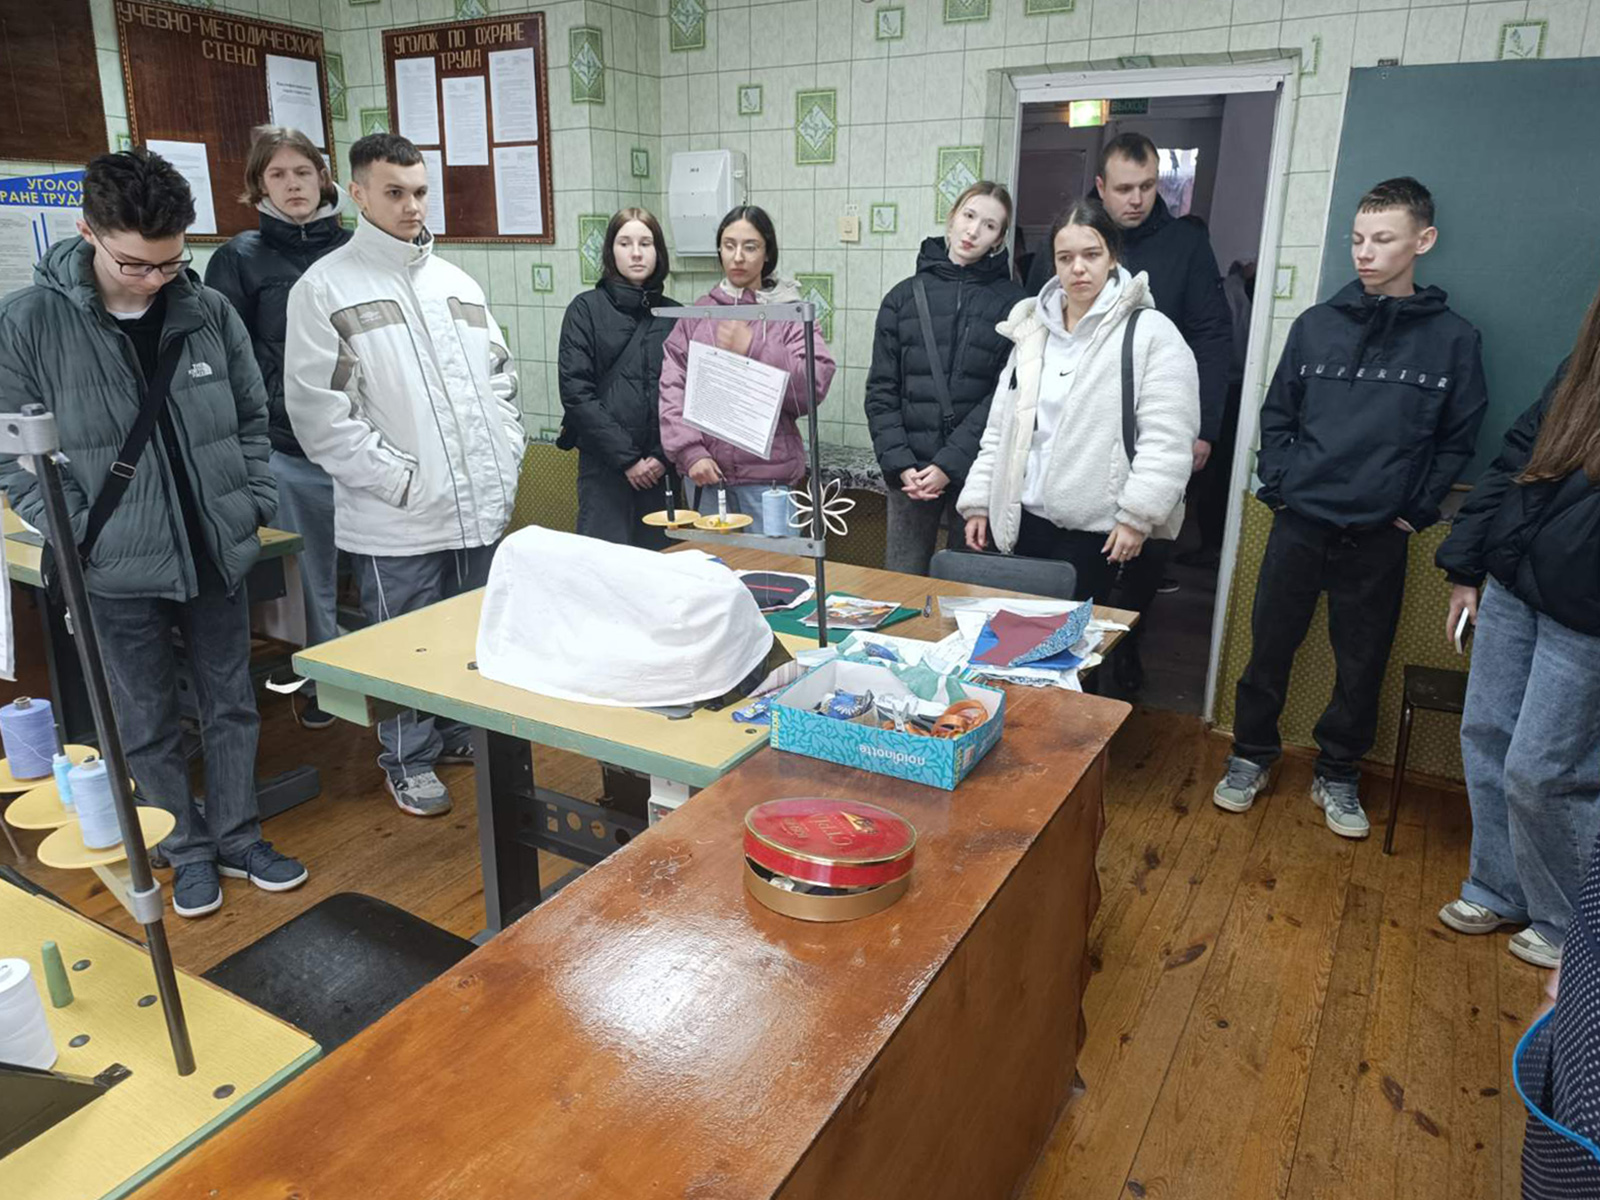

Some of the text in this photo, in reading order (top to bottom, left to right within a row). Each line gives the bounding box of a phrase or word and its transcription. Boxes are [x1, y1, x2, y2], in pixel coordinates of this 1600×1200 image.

[394, 22, 526, 54] УГОЛОК ПО ОХРАНЕ
[201, 39, 257, 67] СТЕНД
[440, 49, 482, 71] ТРУДА
[1299, 363, 1449, 389] SUPERIOR
